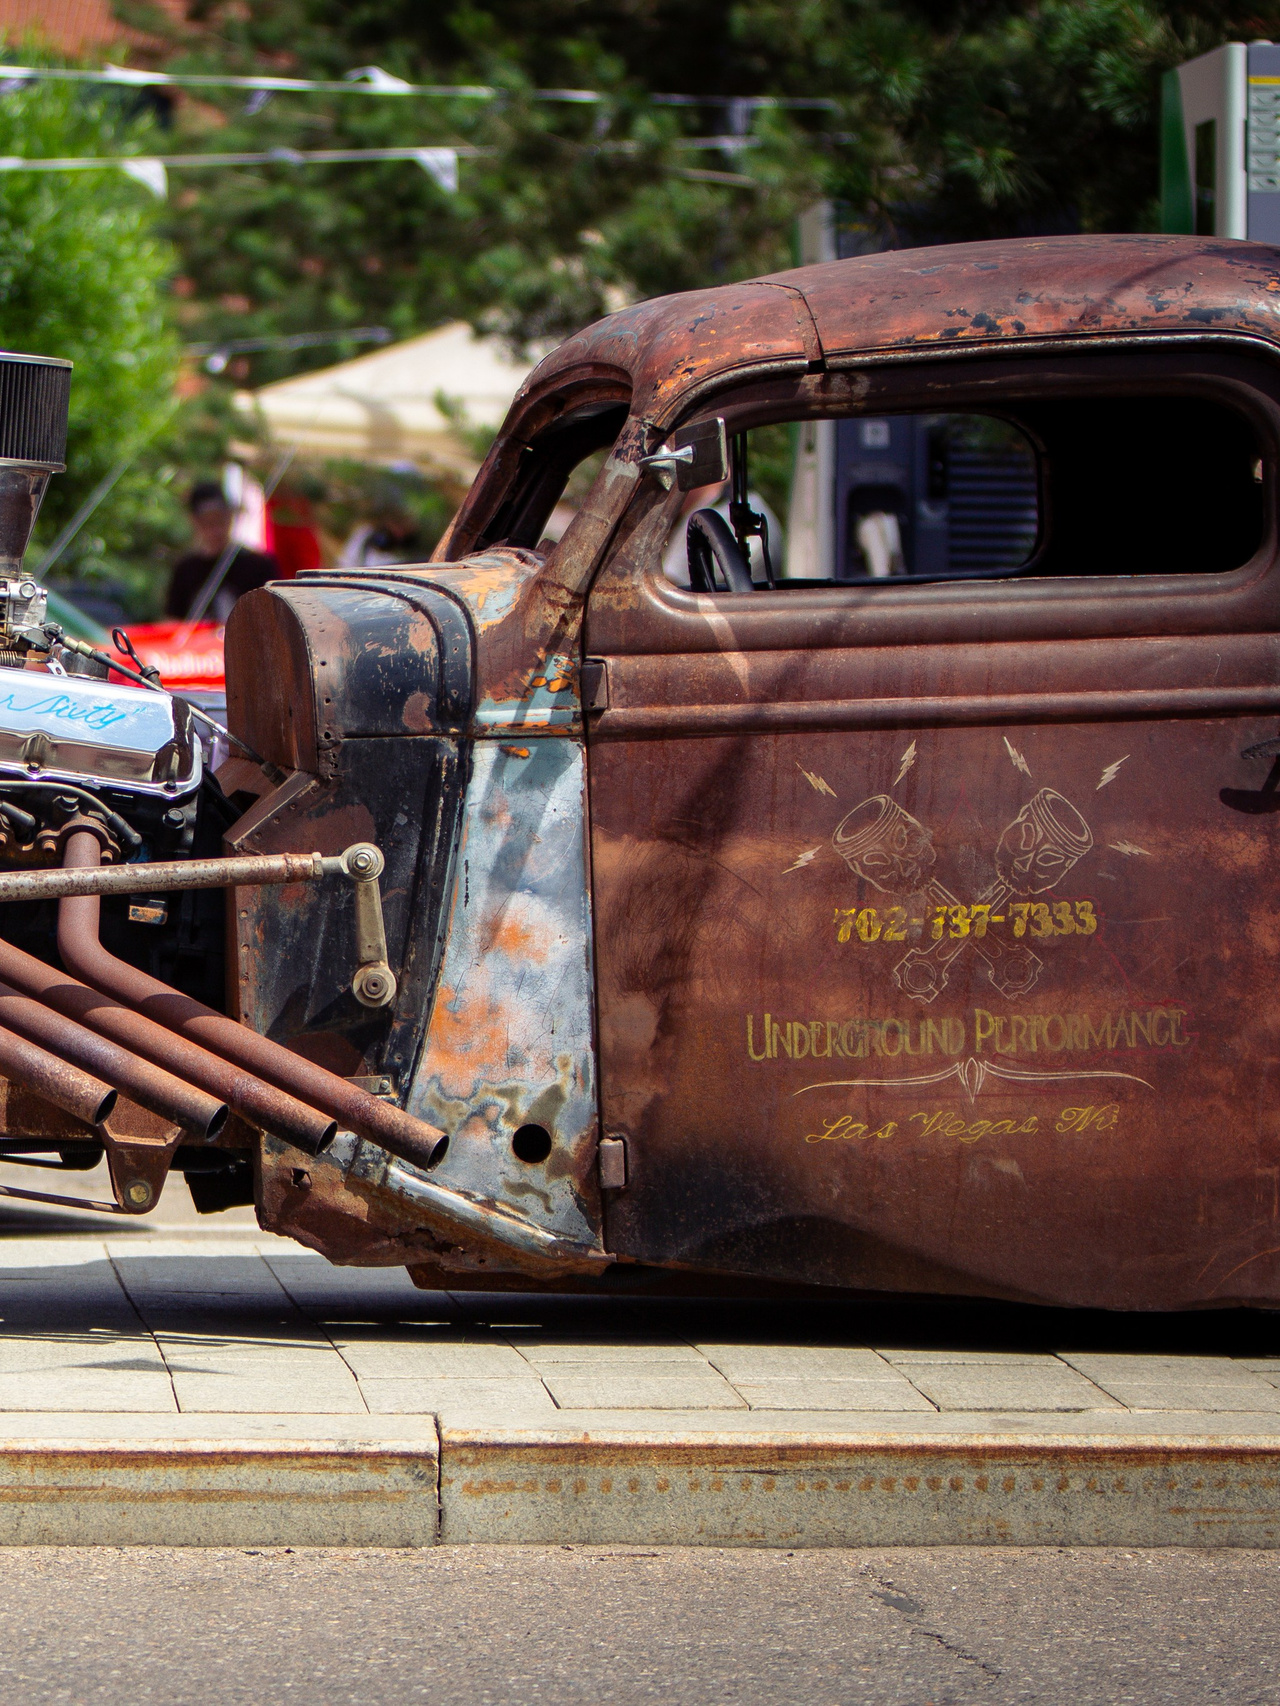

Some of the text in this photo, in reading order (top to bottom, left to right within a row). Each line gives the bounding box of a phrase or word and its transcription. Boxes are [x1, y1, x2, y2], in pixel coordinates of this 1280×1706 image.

[833, 900, 1098, 943] 702-737-7333
[746, 1008, 1191, 1061] UNDERGROUND PERFORMANCE
[805, 1115, 899, 1144] Las
